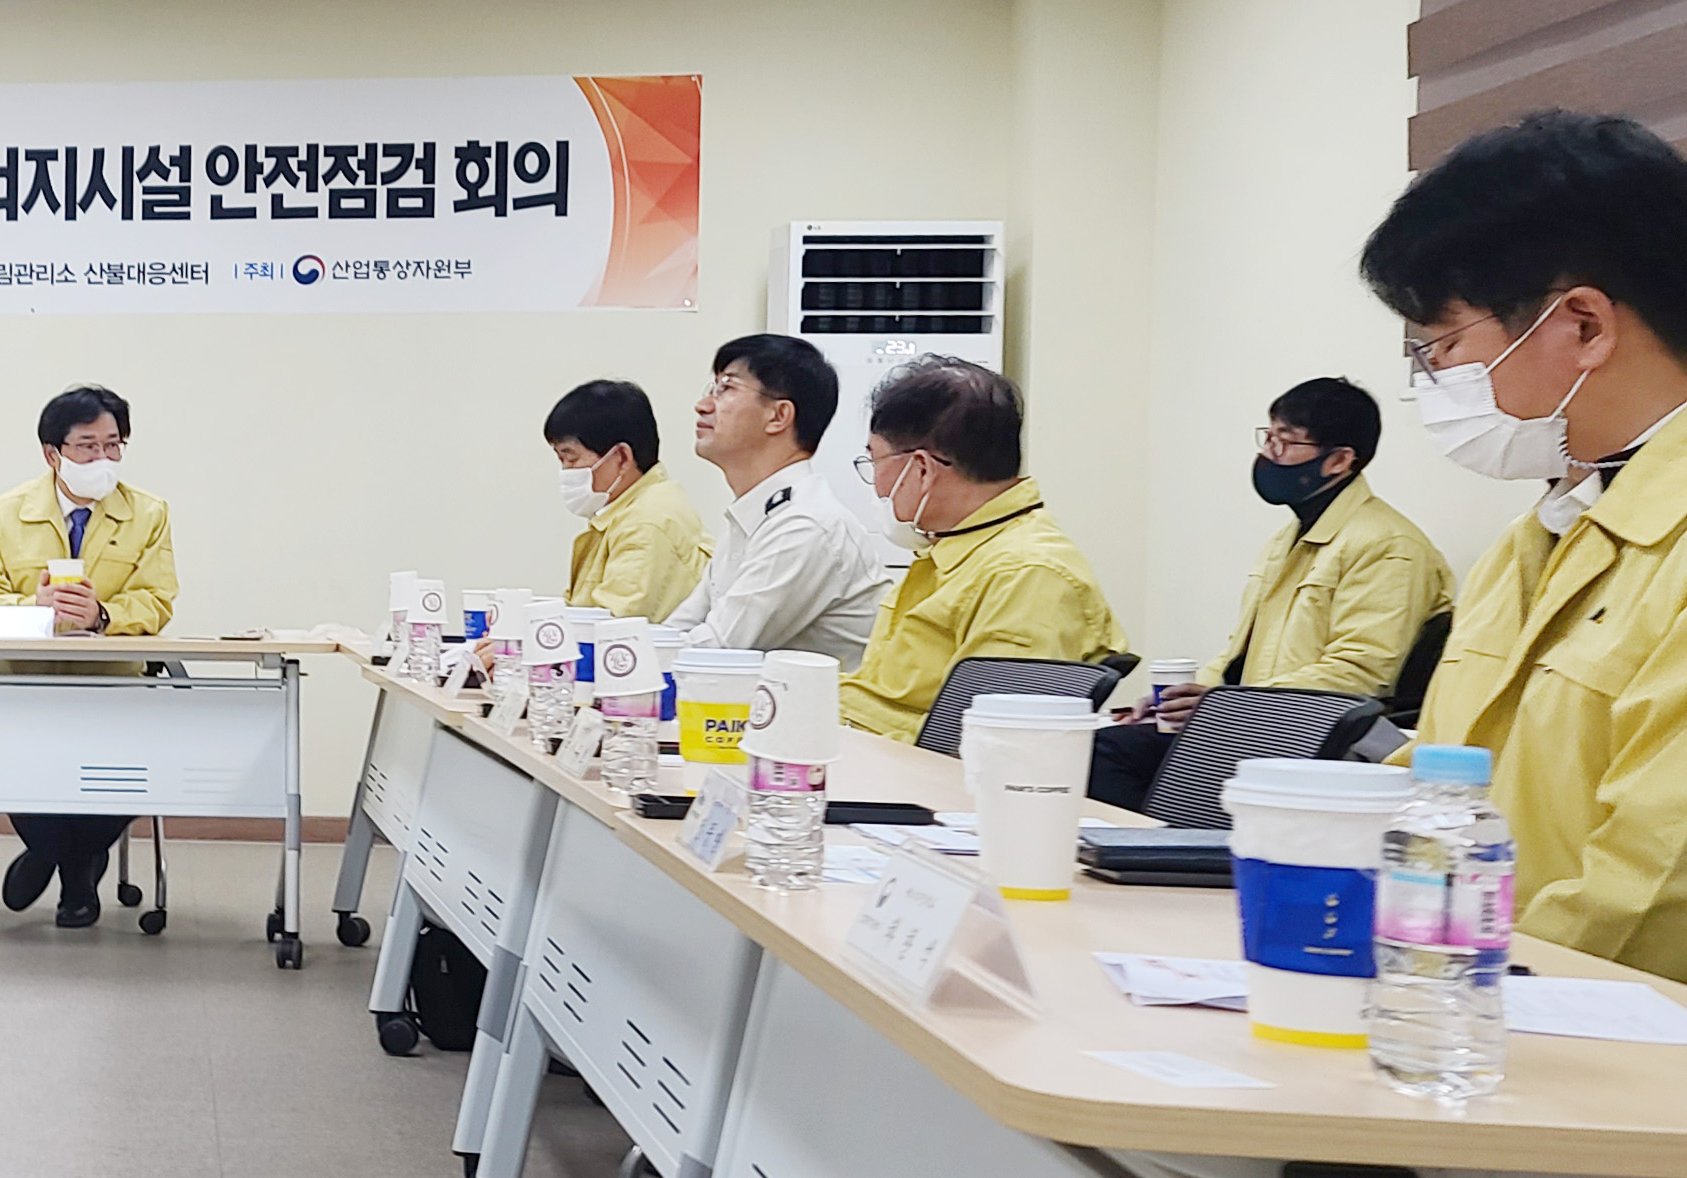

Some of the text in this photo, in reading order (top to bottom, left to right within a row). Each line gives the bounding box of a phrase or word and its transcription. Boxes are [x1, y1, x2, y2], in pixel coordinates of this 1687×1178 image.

[204, 141, 437, 221] 안전점검
[452, 139, 570, 218] 회의
[83, 261, 209, 286] 산불대응센터
[331, 258, 473, 281] 산업통상자원부
